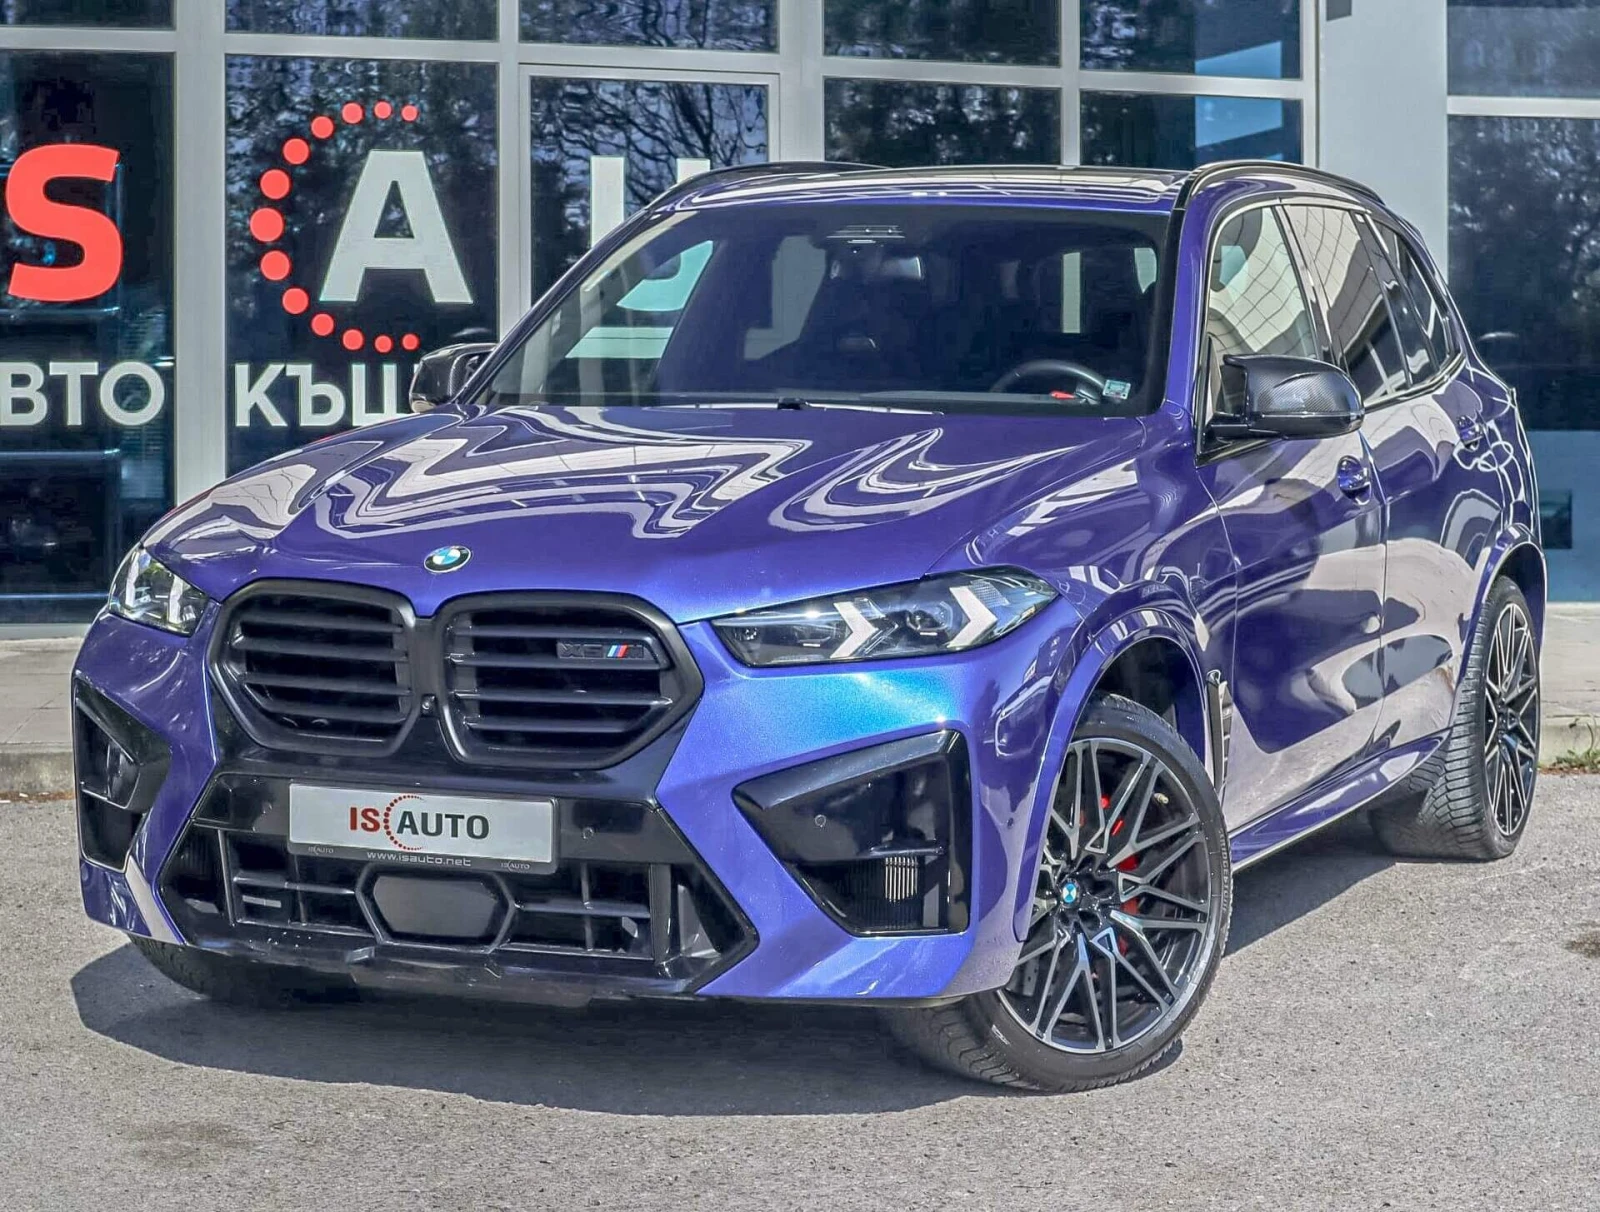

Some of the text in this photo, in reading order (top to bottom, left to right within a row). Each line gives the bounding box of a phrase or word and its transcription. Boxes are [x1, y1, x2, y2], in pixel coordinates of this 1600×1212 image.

[234, 363, 421, 428] КЪЩ
[349, 806, 490, 840] IS AUTO
[367, 852, 471, 866] www.isauto.net
